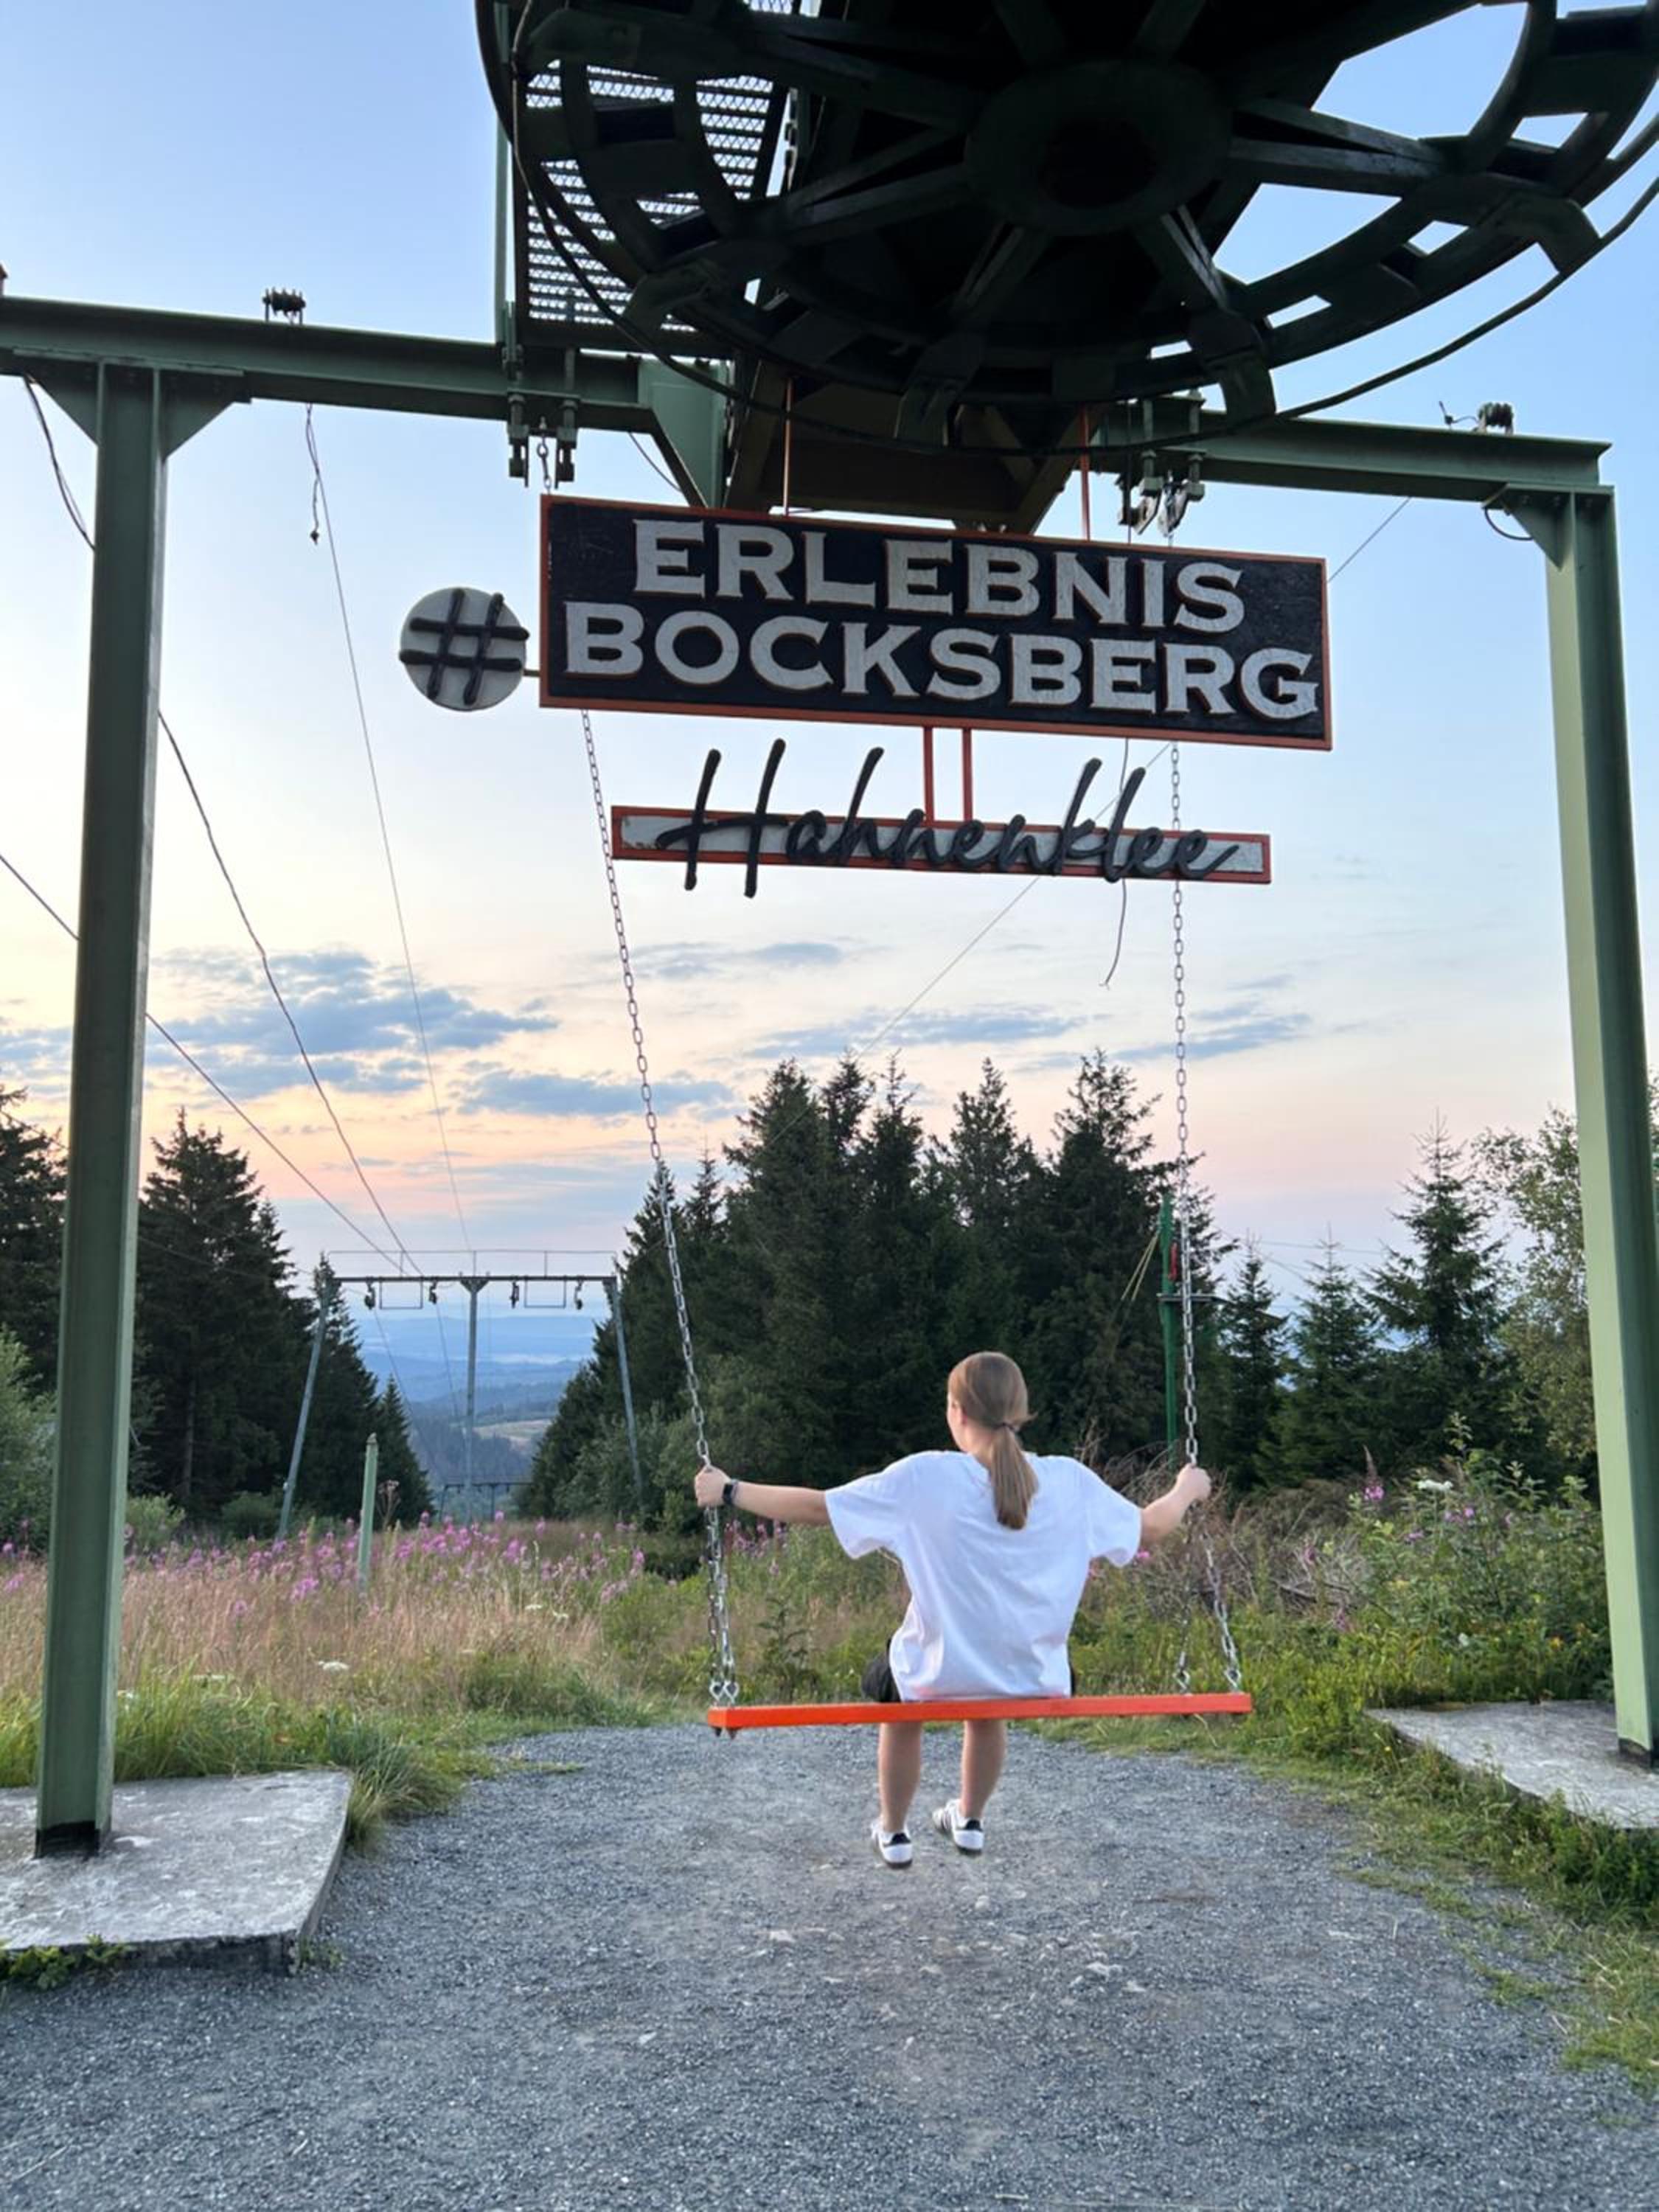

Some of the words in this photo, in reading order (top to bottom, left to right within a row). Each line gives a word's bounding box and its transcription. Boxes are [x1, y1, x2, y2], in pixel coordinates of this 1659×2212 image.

[632, 518, 1244, 633] ERLEBNIS
[563, 601, 1318, 719] BOCKSBERG
[655, 738, 1239, 898] Hahnenklee
